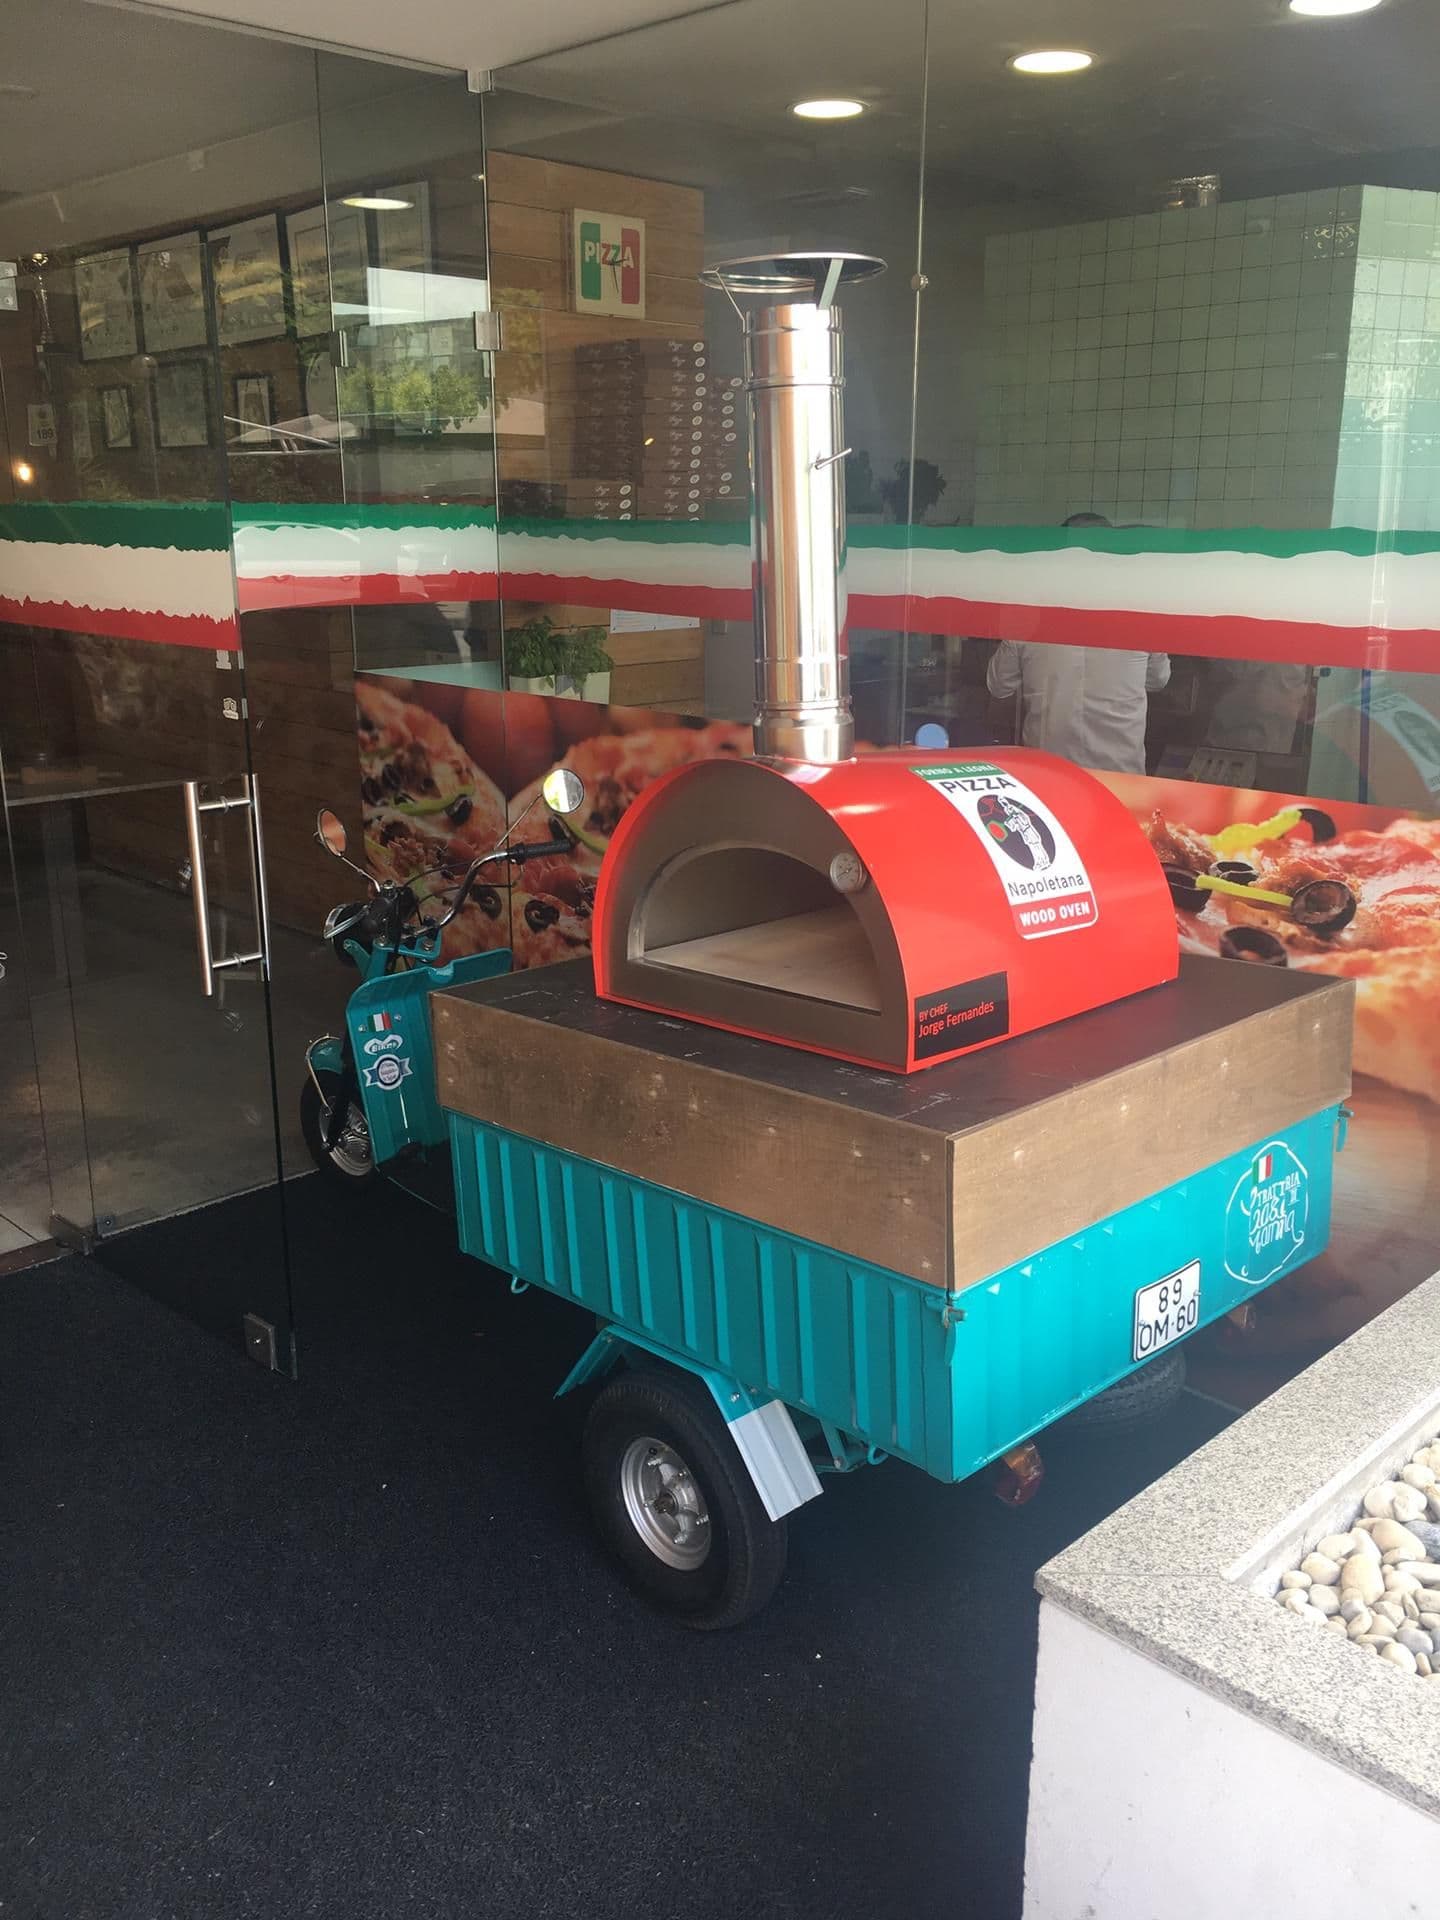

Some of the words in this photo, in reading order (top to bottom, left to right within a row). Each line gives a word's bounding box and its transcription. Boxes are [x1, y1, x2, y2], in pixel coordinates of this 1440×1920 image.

[584, 240, 634, 269] PIZZA
[939, 777, 1017, 793] PIZZA
[1007, 874, 1084, 898] Napoletana
[1019, 908, 1057, 927] WOOD
[1059, 901, 1091, 919] OVEN
[918, 1020, 945, 1038] Jorge
[946, 1001, 995, 1028] Fernandes
[919, 1009, 929, 1023] BY
[929, 1002, 949, 1018] CHEF
[1158, 1278, 1183, 1314] 89
